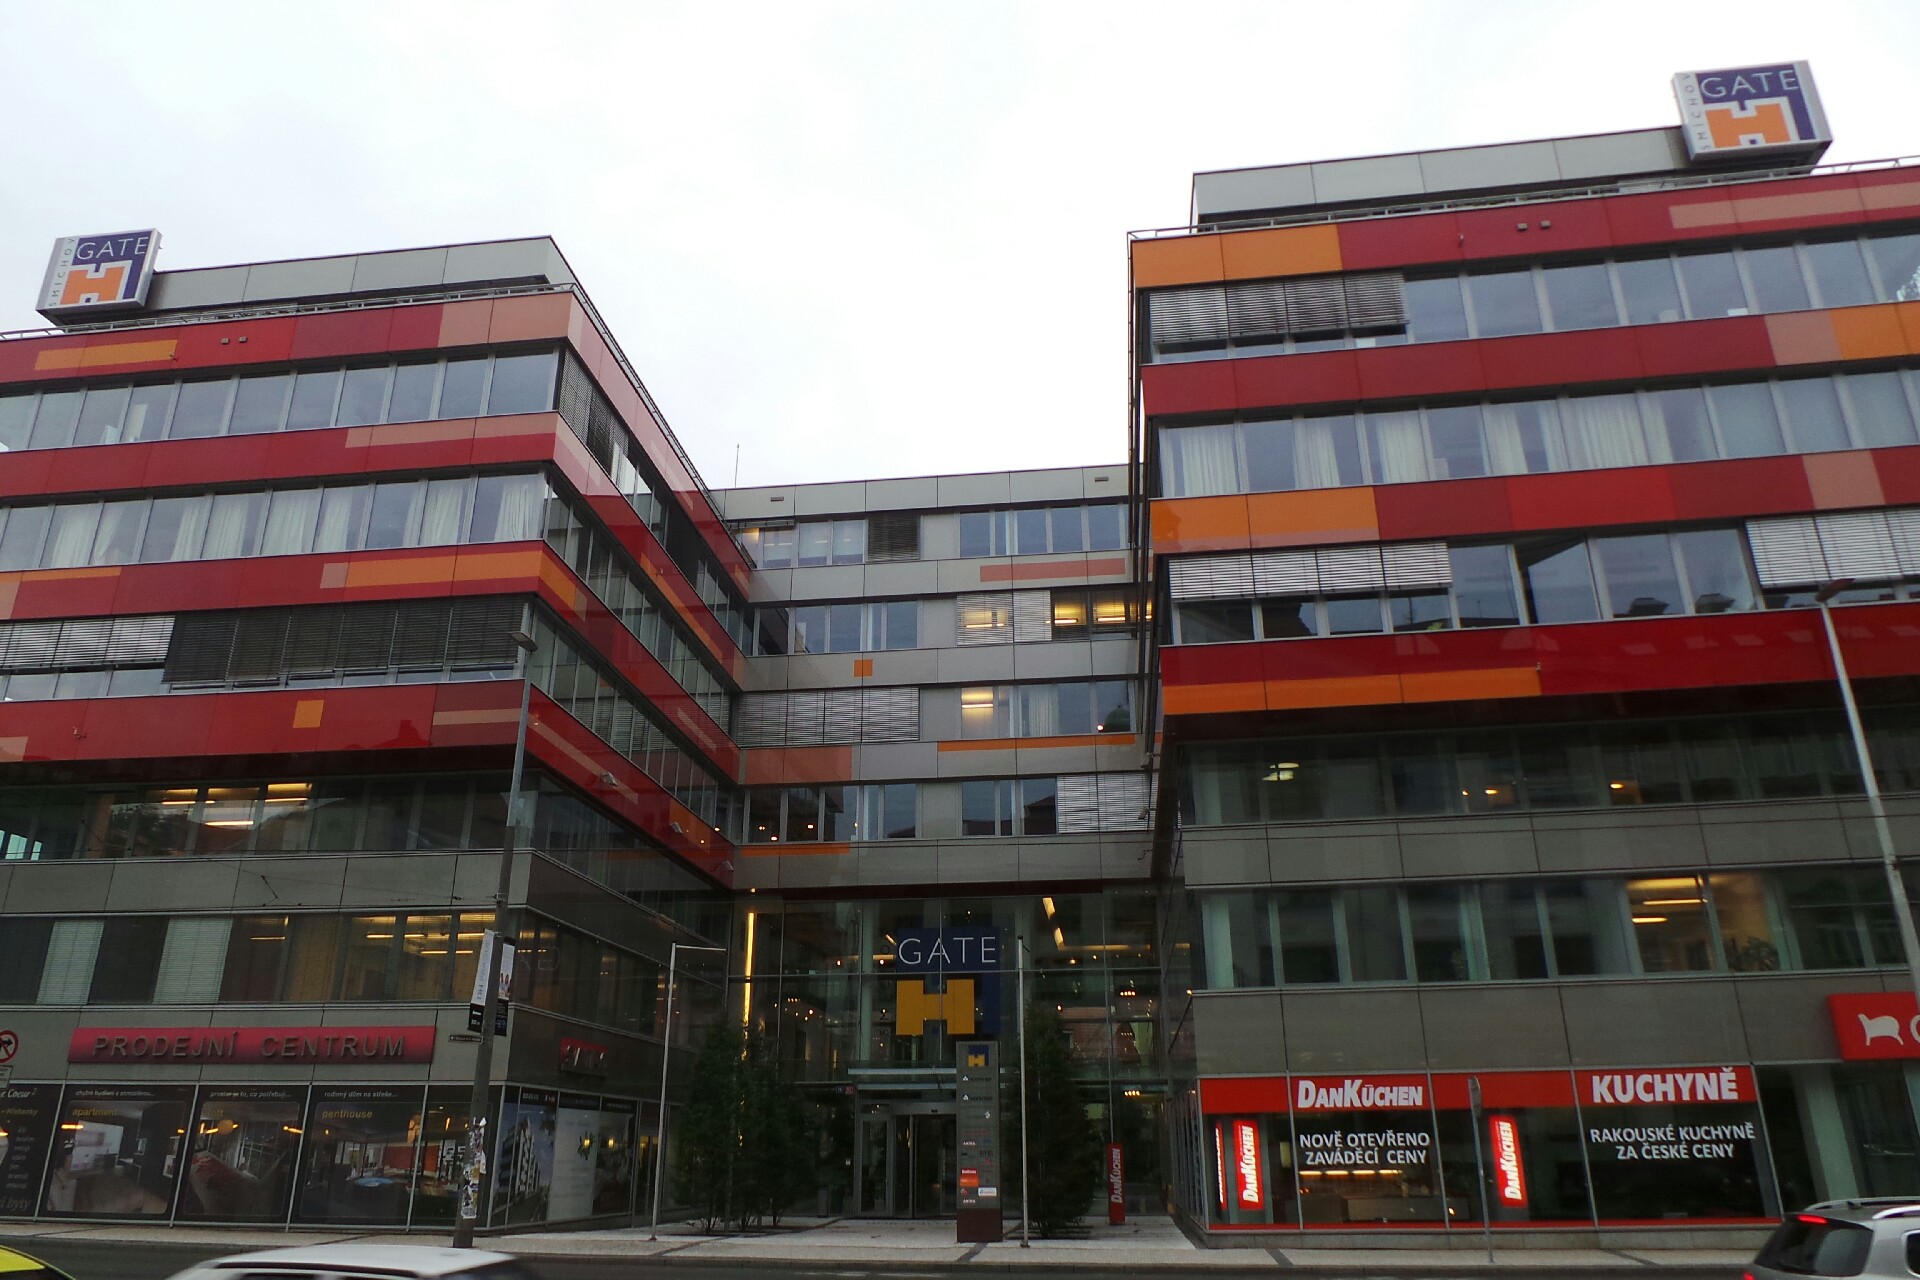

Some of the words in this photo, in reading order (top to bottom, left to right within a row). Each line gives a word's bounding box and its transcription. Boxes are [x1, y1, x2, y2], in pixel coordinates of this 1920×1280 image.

[1700, 69, 1799, 98] GATE
[76, 236, 150, 260] GATE
[898, 936, 997, 965] GATE
[92, 1031, 239, 1057] PRODEJNÍ
[260, 1034, 406, 1058] CENTRUM
[1592, 1067, 1738, 1104] KUCHYNĚ
[72, 1106, 119, 1118] apartment
[322, 1109, 373, 1119] penthouse
[1299, 1129, 1343, 1149] NOVĚ
[1346, 1129, 1430, 1149] OTEVŘENO
[1590, 1123, 1676, 1143] RAKOUSKÉ
[1679, 1122, 1756, 1142] KUCHYNĚ
[1305, 1146, 1379, 1165] ZAVÁDĚCÍ
[1386, 1149, 1427, 1164] CENY
[1616, 1144, 1639, 1160] ZA
[1641, 1141, 1689, 1160] ČESKÉ
[1692, 1142, 1735, 1159] CENY
